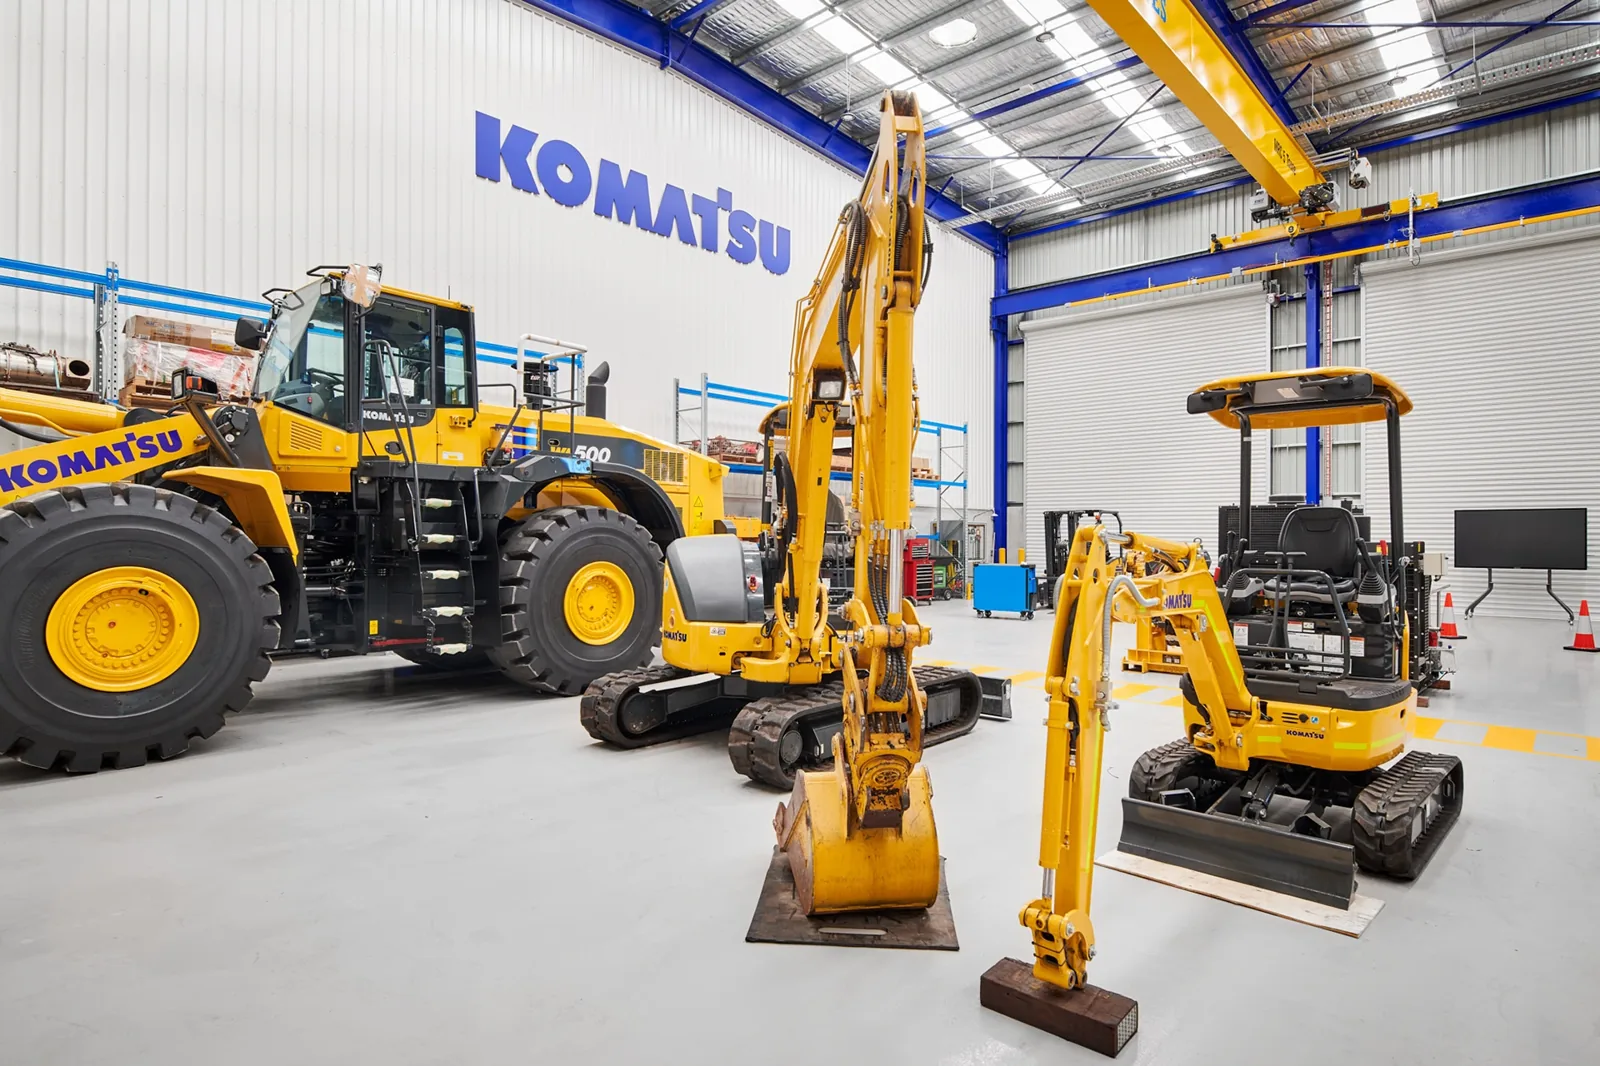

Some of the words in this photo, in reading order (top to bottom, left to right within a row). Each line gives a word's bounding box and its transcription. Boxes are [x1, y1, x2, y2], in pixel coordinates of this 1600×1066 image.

[475, 110, 791, 276] KOMATSU
[0, 429, 183, 493] KOMATSU
[574, 444, 611, 463] 500
[1286, 729, 1325, 740] KOMATSU
